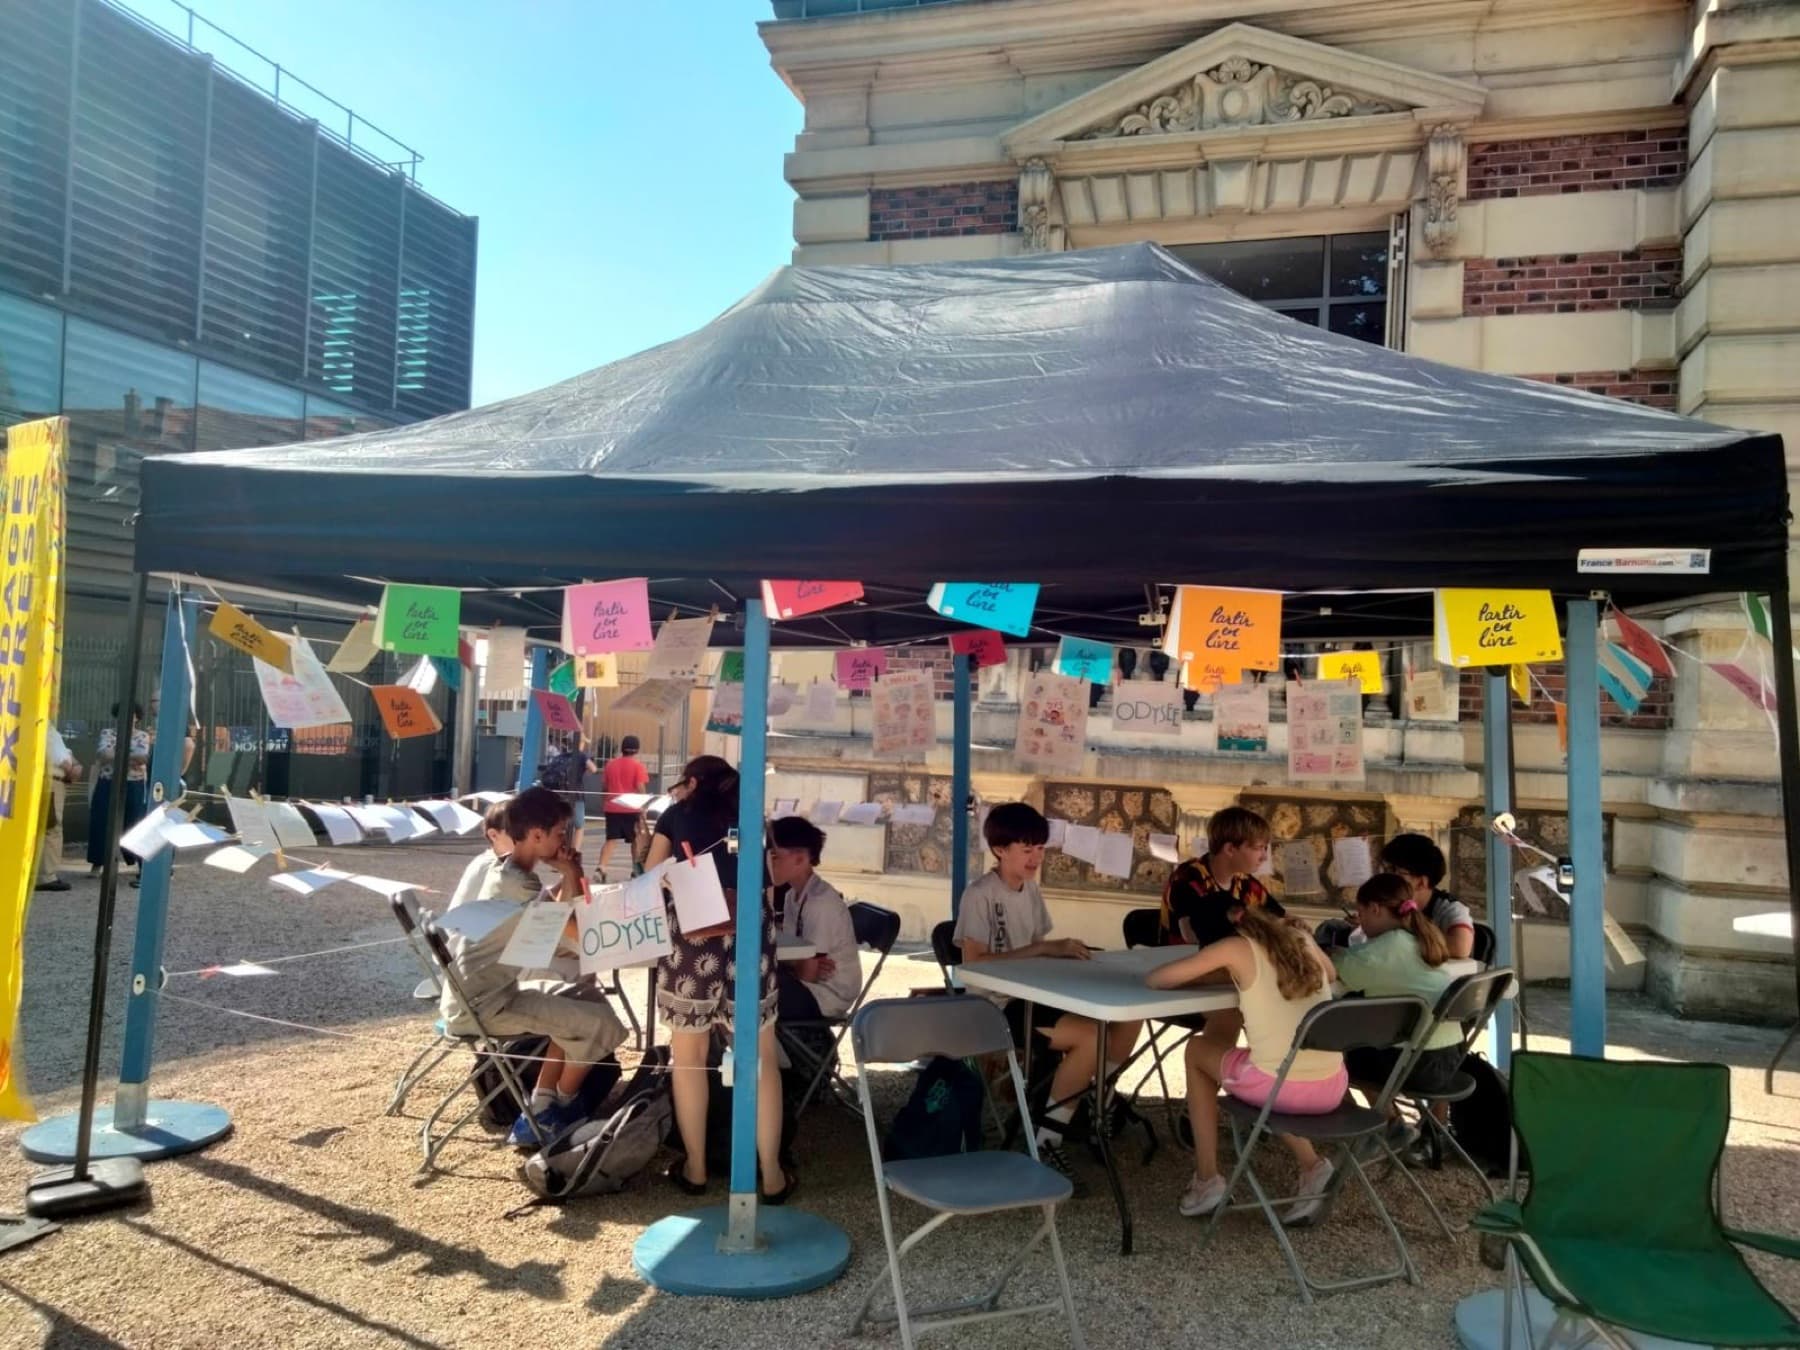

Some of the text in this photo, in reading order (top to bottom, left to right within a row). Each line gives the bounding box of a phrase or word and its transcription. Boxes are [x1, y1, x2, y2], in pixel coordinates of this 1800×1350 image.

[1580, 558, 1613, 567] France
[1209, 605, 1255, 628] Partir
[1478, 602, 1527, 622] Partir
[1221, 626, 1241, 637] en
[1493, 621, 1513, 632] en
[0, 474, 39, 819] EXPRESS
[1205, 628, 1241, 651] livre
[1478, 627, 1518, 648] livre
